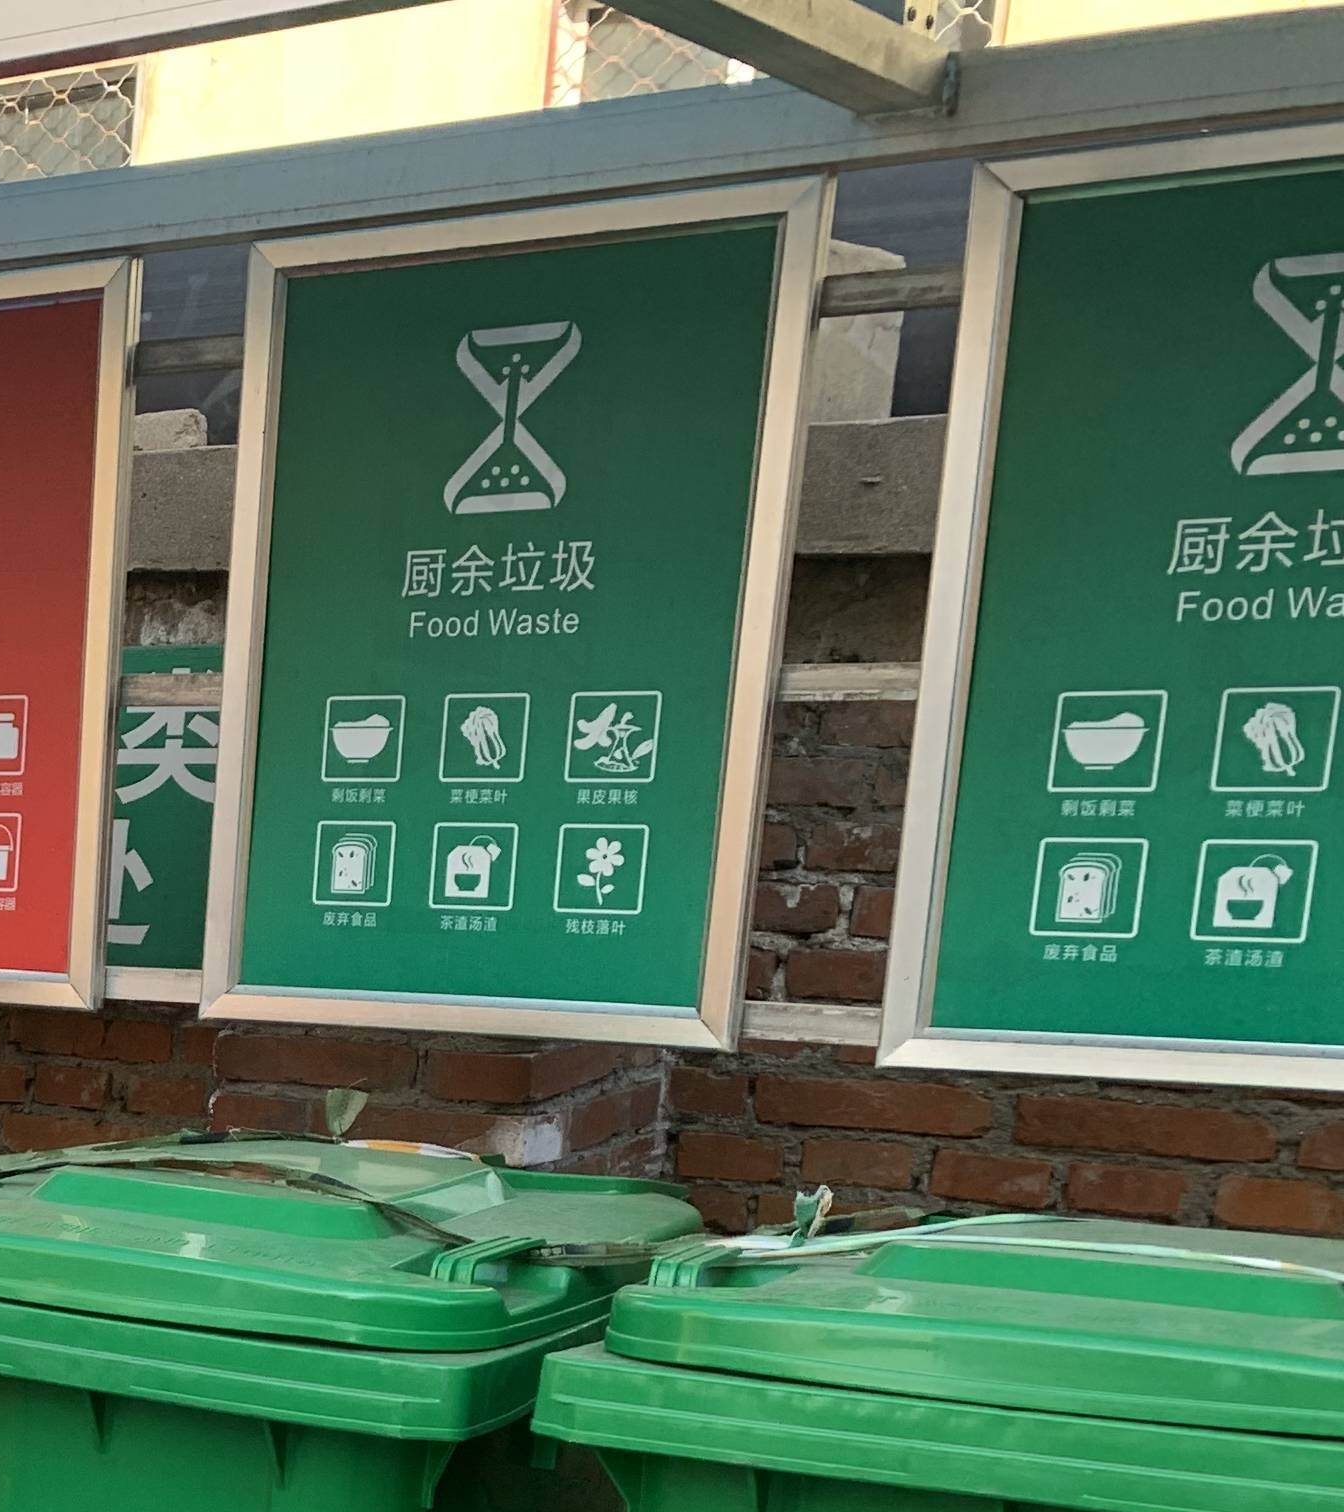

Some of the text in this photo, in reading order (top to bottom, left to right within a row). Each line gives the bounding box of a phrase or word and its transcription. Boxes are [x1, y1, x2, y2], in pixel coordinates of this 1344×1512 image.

[402, 540, 595, 598] 厨余垃圾
[1176, 588, 1274, 622] Food
[409, 608, 580, 638] Food Waste
[331, 788, 386, 804] 剩饭剩菜
[450, 788, 508, 804] 菜梗菜叶
[577, 788, 639, 806] 果皮果核
[1061, 800, 1136, 818] 剩饭剩菜
[1225, 800, 1306, 819] 菜梗菜叶
[323, 912, 377, 928] 废弃食品
[440, 915, 498, 932] 茶渣汤渣
[566, 919, 626, 936] 残枝落叶
[1043, 943, 1118, 963] 废弃食品
[1203, 948, 1284, 968] 茶渣汤渣
